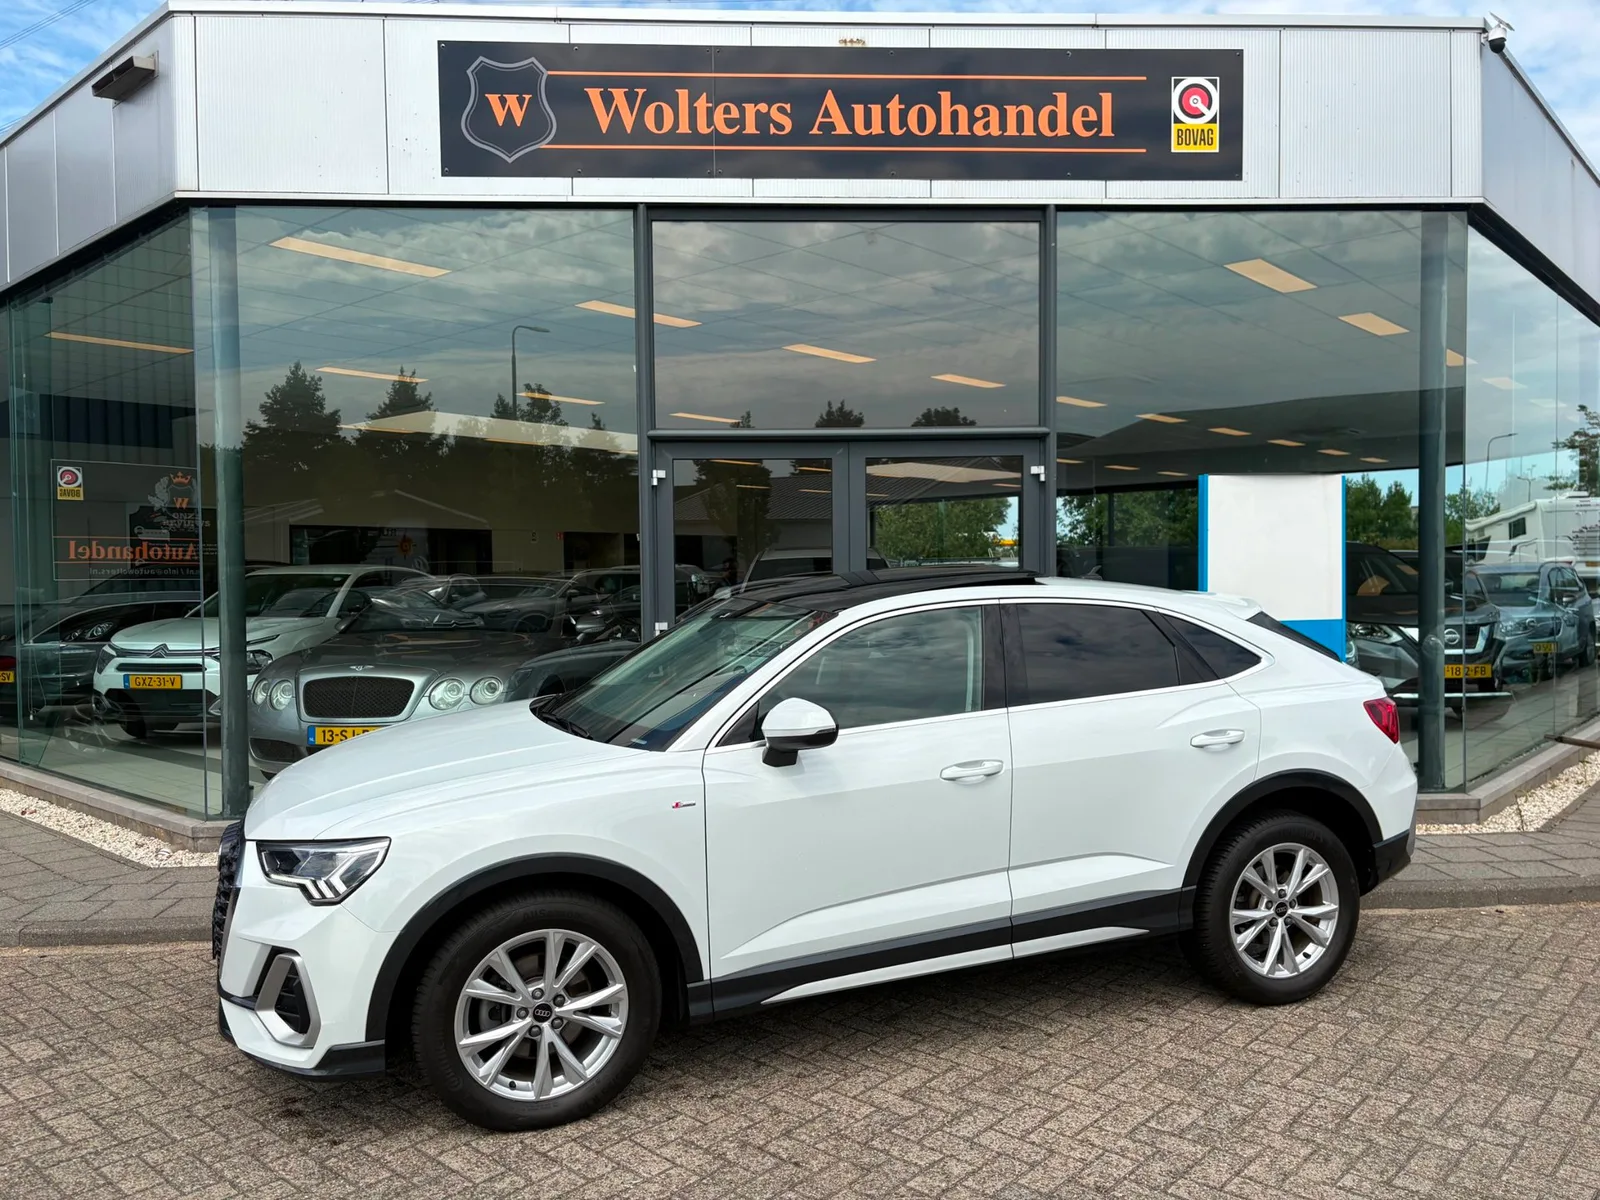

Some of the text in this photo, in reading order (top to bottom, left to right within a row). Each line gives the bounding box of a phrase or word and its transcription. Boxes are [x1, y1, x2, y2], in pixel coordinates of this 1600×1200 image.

[485, 94, 532, 126] W
[584, 87, 1115, 137] Wolters Autohandel
[1176, 128, 1214, 146] BOVAG
[134, 676, 176, 687] GXZ-31-V
